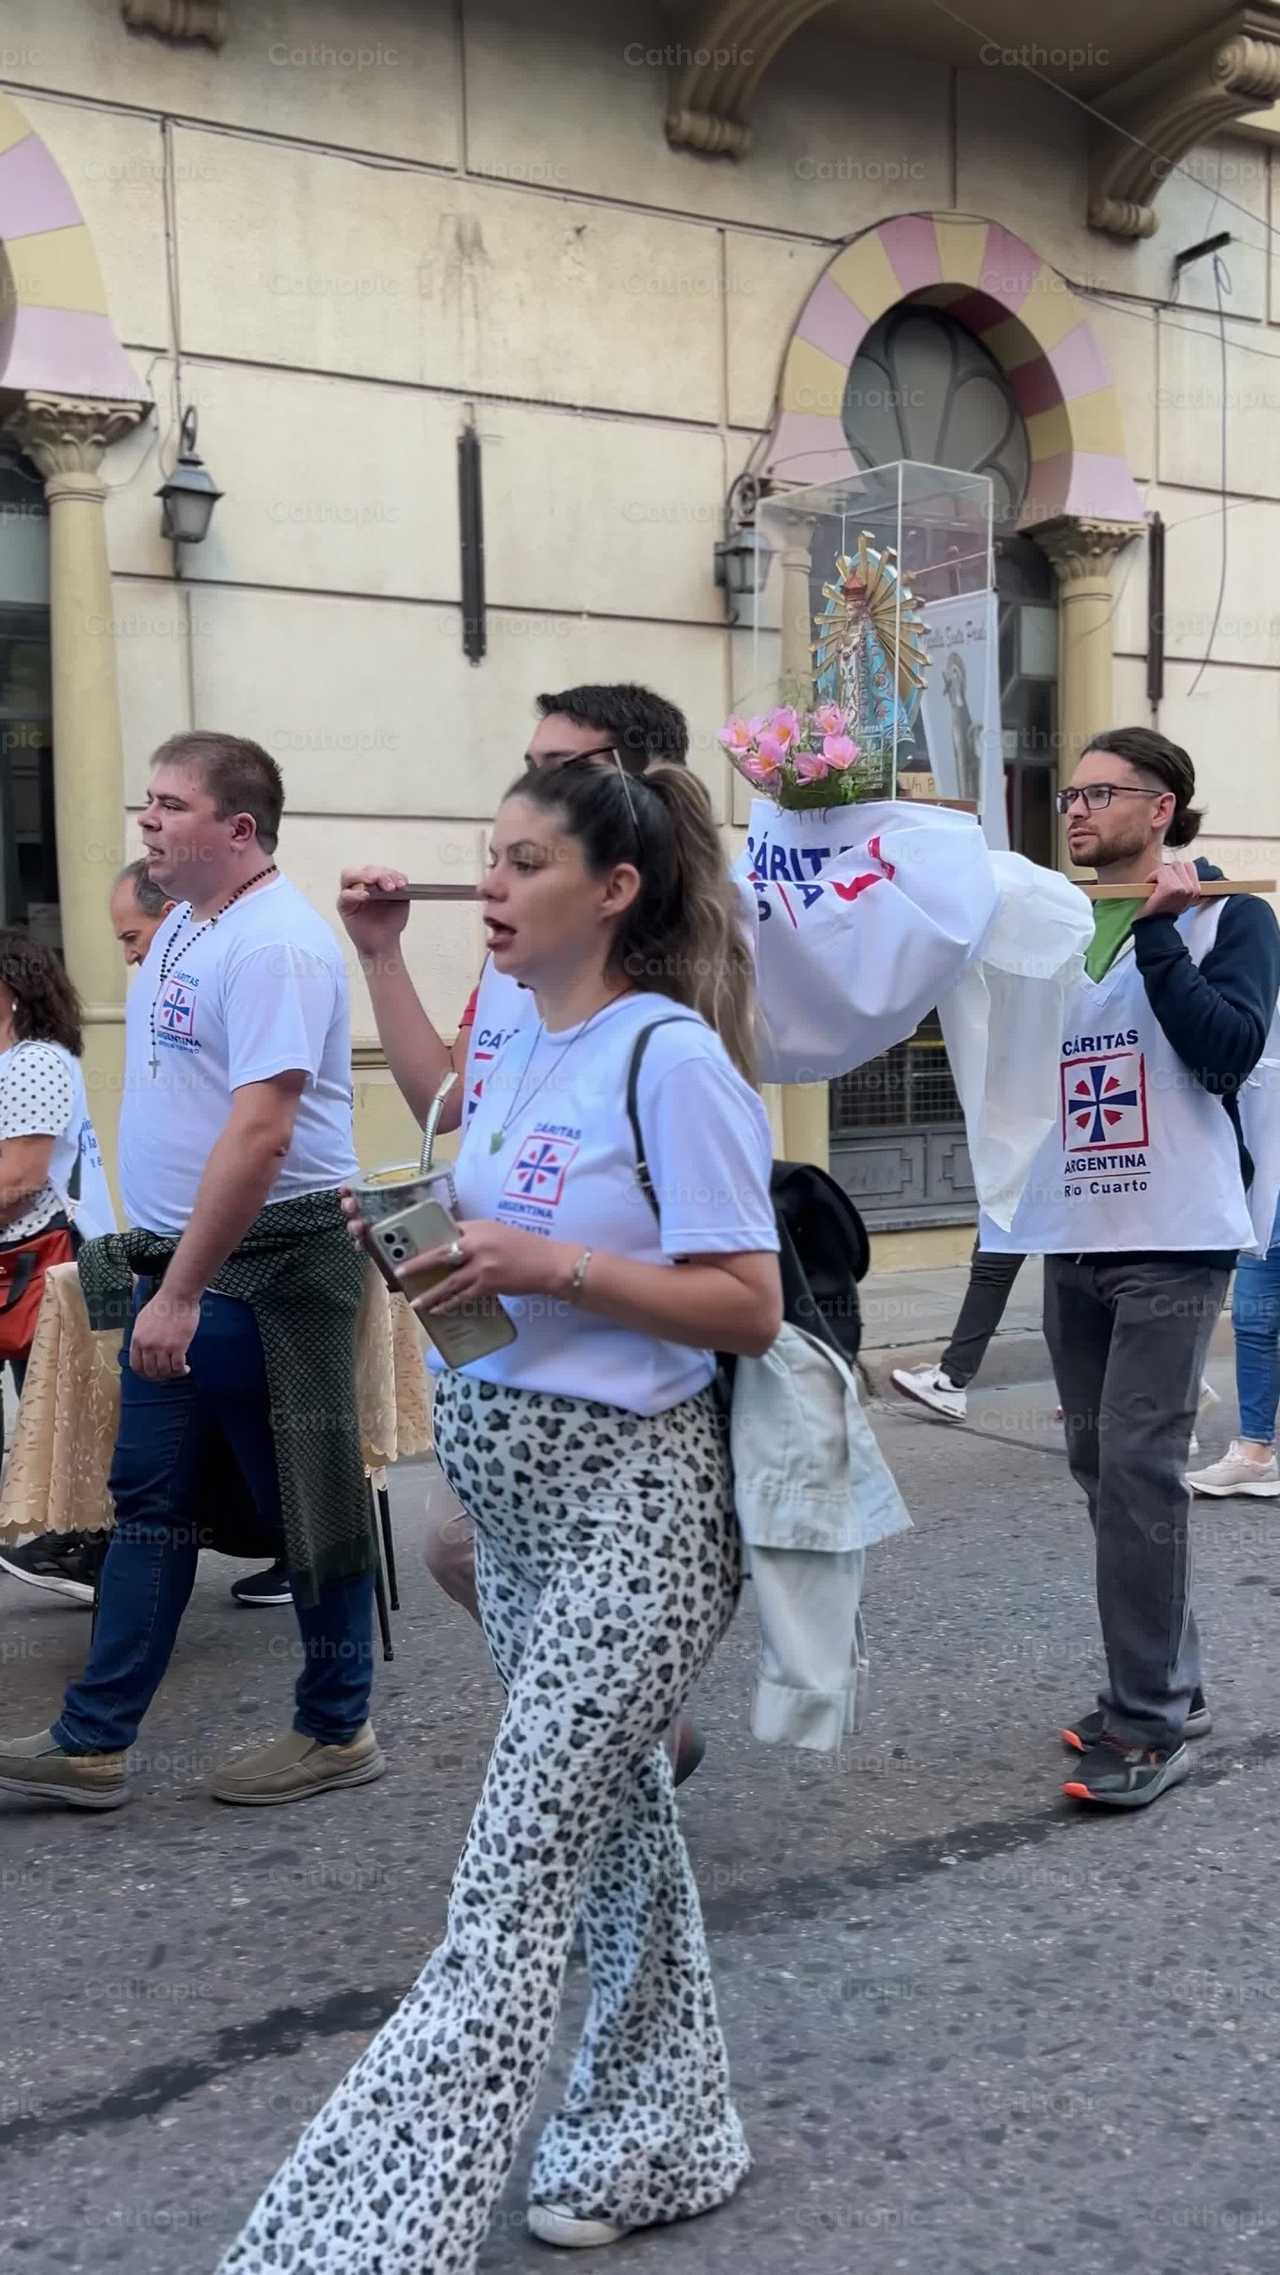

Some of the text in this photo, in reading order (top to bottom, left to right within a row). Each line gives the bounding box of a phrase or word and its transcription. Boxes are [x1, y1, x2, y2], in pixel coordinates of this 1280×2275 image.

[1062, 1029, 1139, 1056] CÁRITAS
[1064, 1153, 1147, 1174] ARGENTINA
[1090, 1180, 1148, 1195] Cuarto
